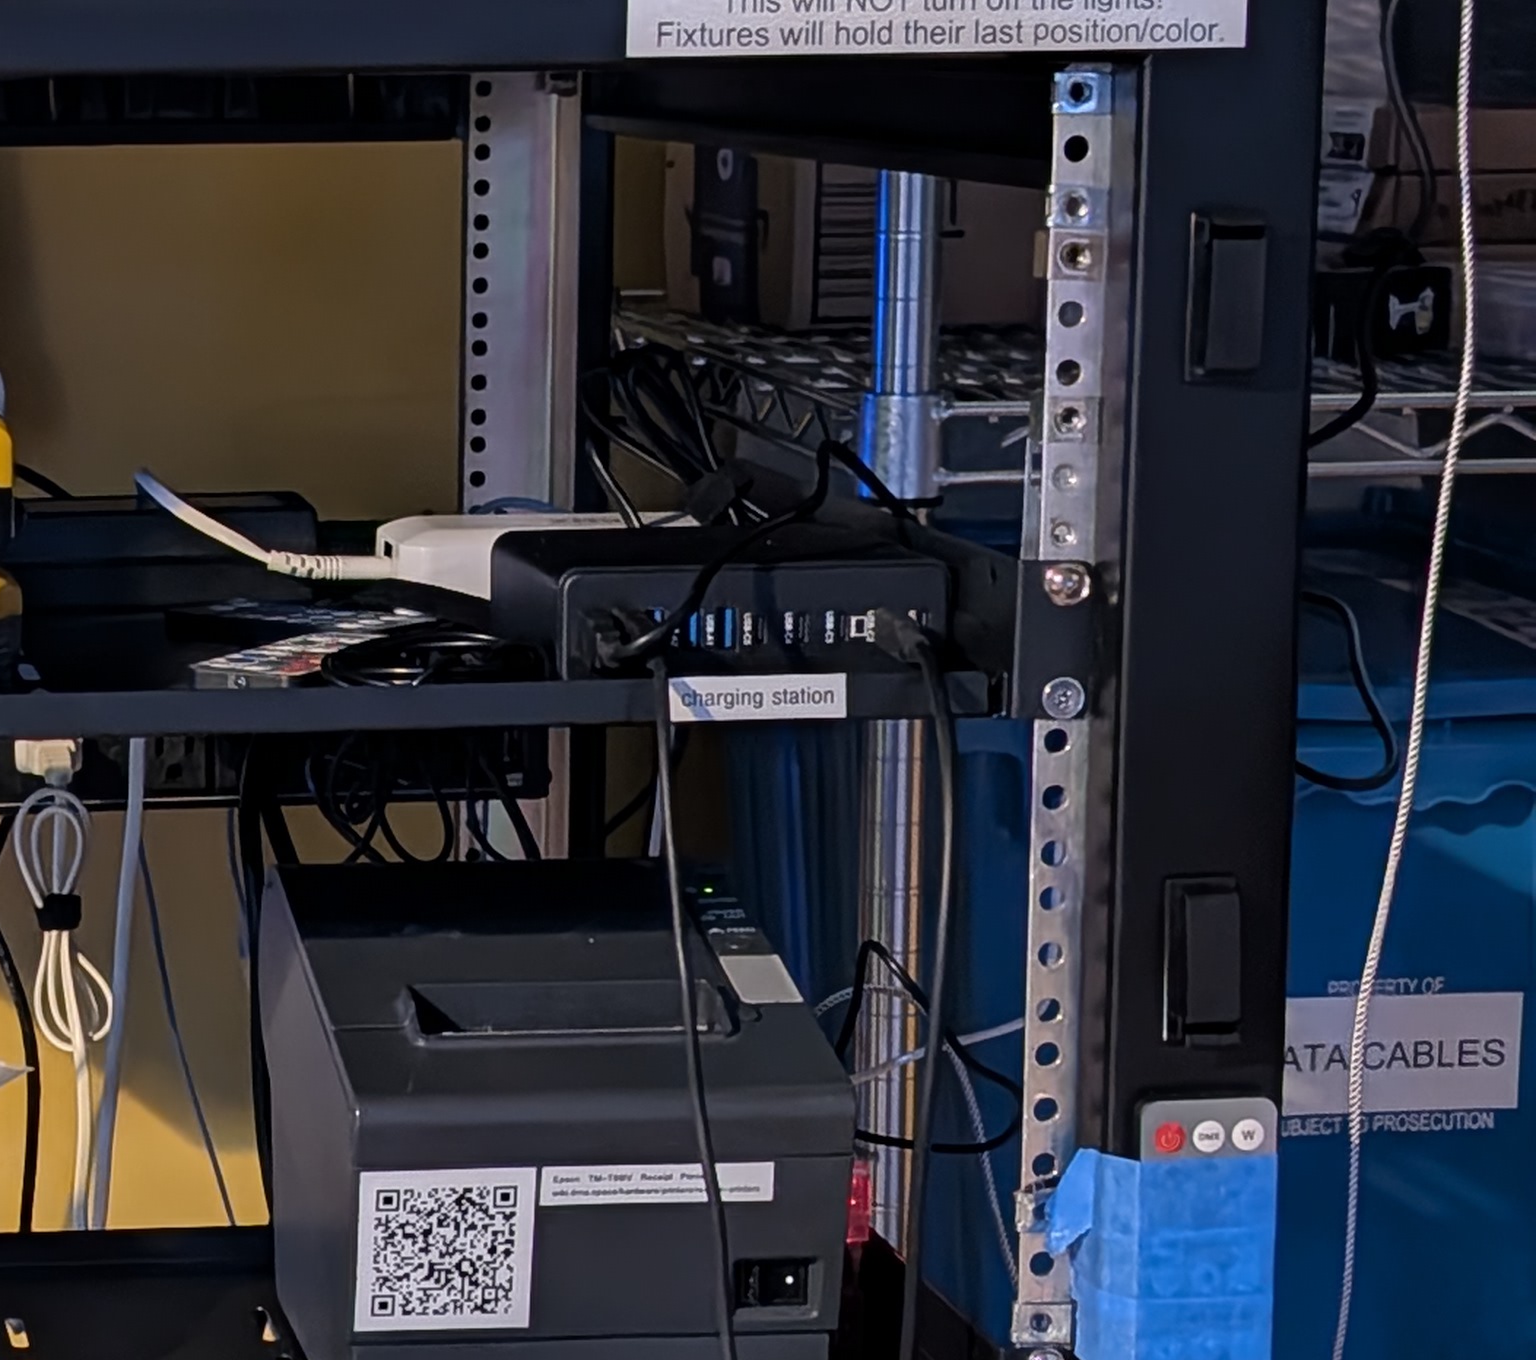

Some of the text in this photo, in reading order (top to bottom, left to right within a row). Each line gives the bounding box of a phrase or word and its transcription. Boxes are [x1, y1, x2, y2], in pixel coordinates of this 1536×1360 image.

[656, 17, 1225, 47] Fixtures will hold their last position/color.
[681, 686, 835, 708] charging station
[1422, 976, 1445, 994] OF
[1284, 1038, 1506, 1072] ATA CABLES
[1373, 1111, 1495, 1132] PROSECUTION
[1242, 1129, 1256, 1141] W
